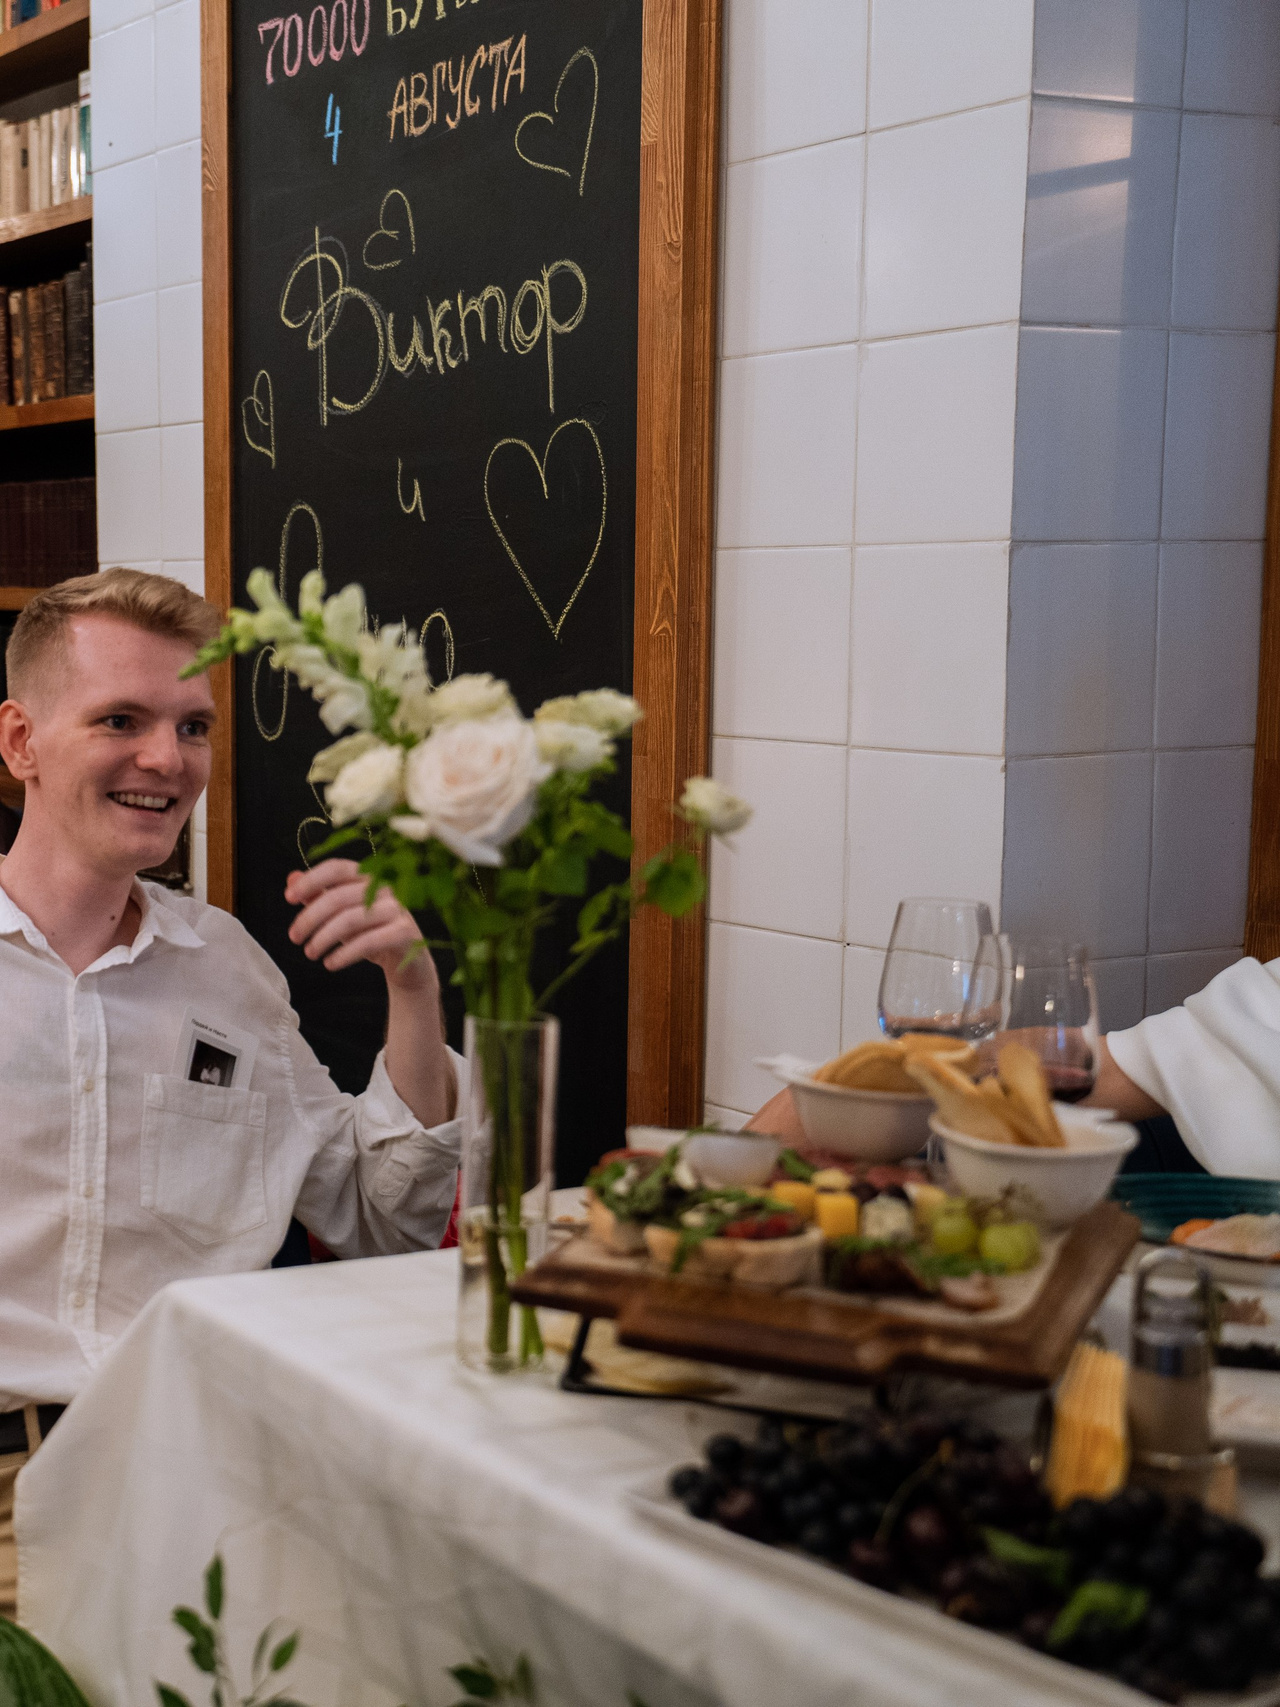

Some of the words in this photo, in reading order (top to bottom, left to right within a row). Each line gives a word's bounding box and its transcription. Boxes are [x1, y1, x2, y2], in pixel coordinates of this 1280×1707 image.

[257, 0, 370, 85] 70000
[324, 93, 343, 165] 4
[386, 31, 526, 142] АВГУСТА
[280, 226, 588, 426] Виктор
